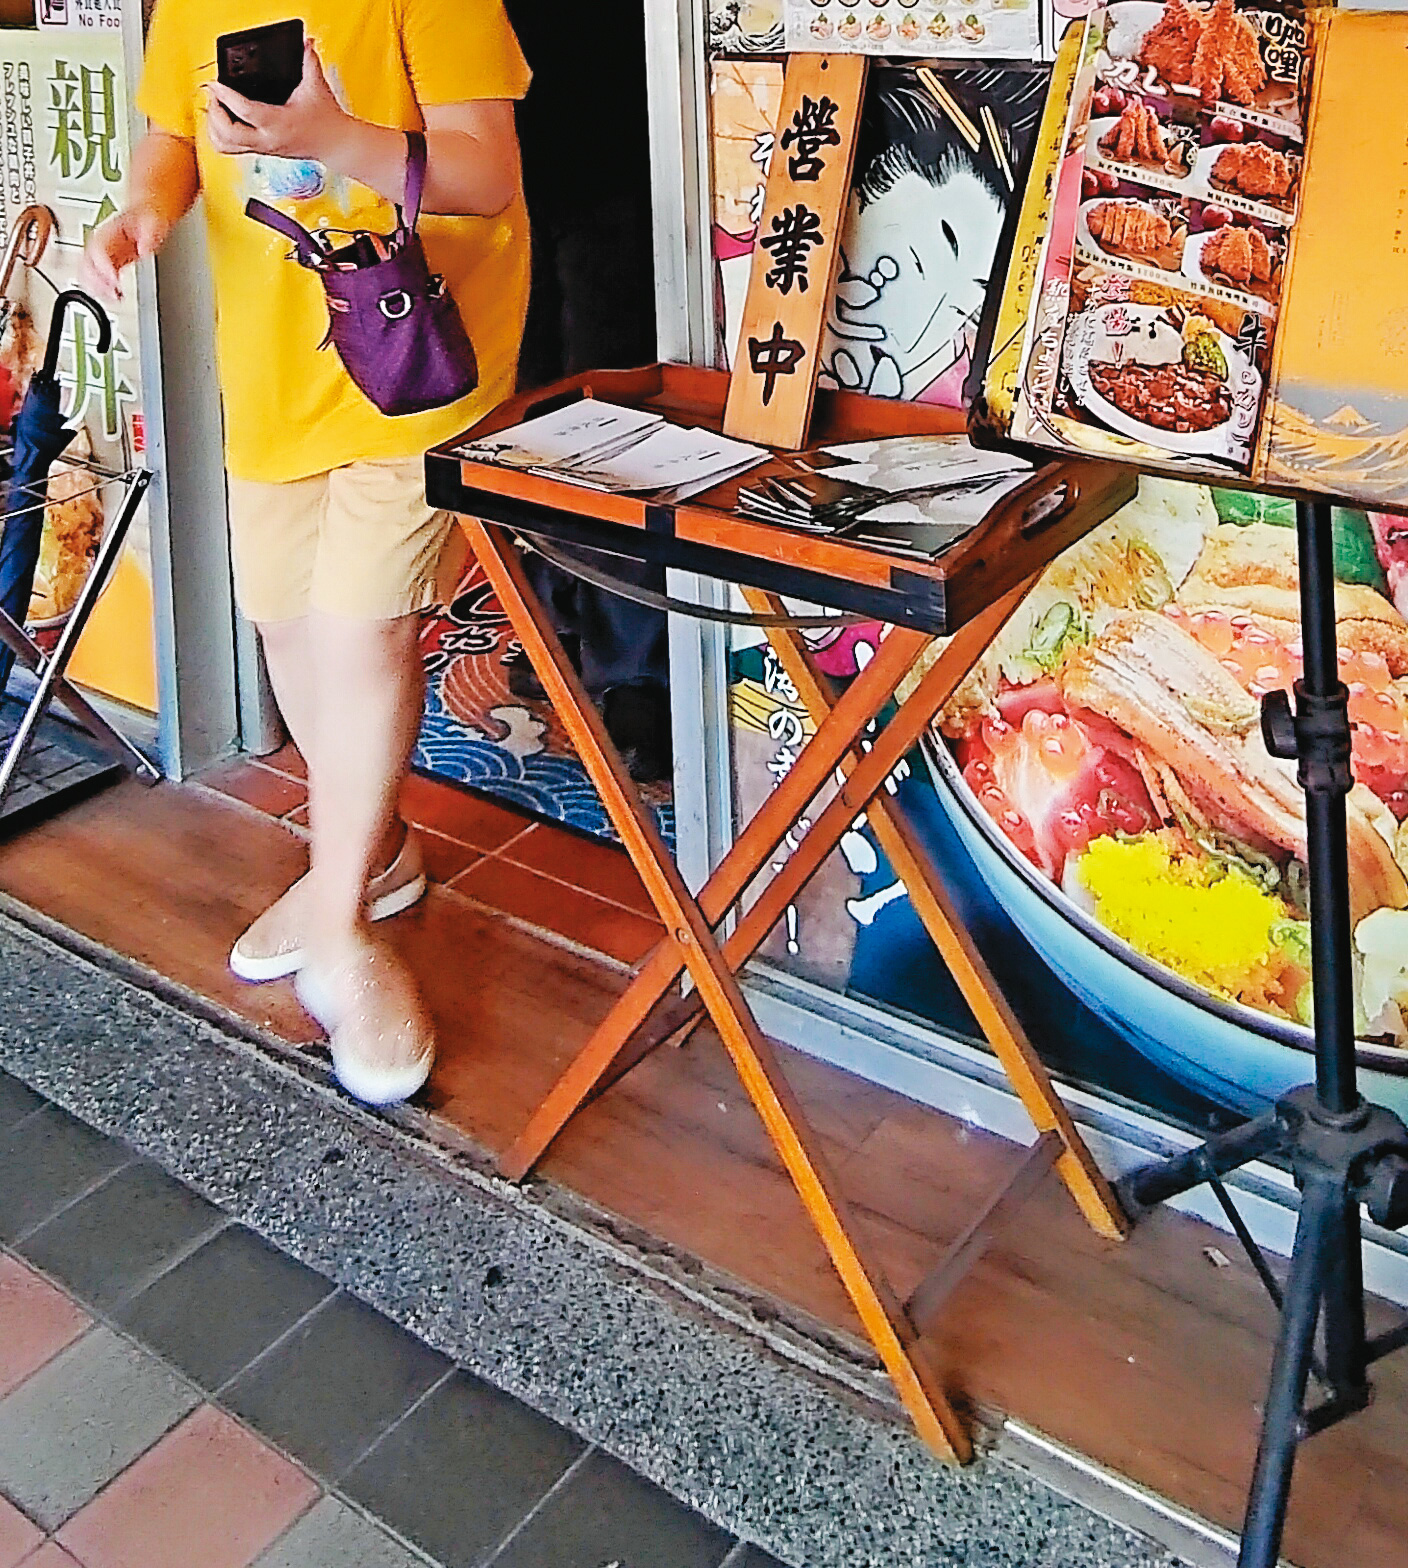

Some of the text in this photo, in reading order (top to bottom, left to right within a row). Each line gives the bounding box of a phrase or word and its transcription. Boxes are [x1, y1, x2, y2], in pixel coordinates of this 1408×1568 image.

[79, 14, 93, 27] No
[748, 94, 841, 407] 營業中
